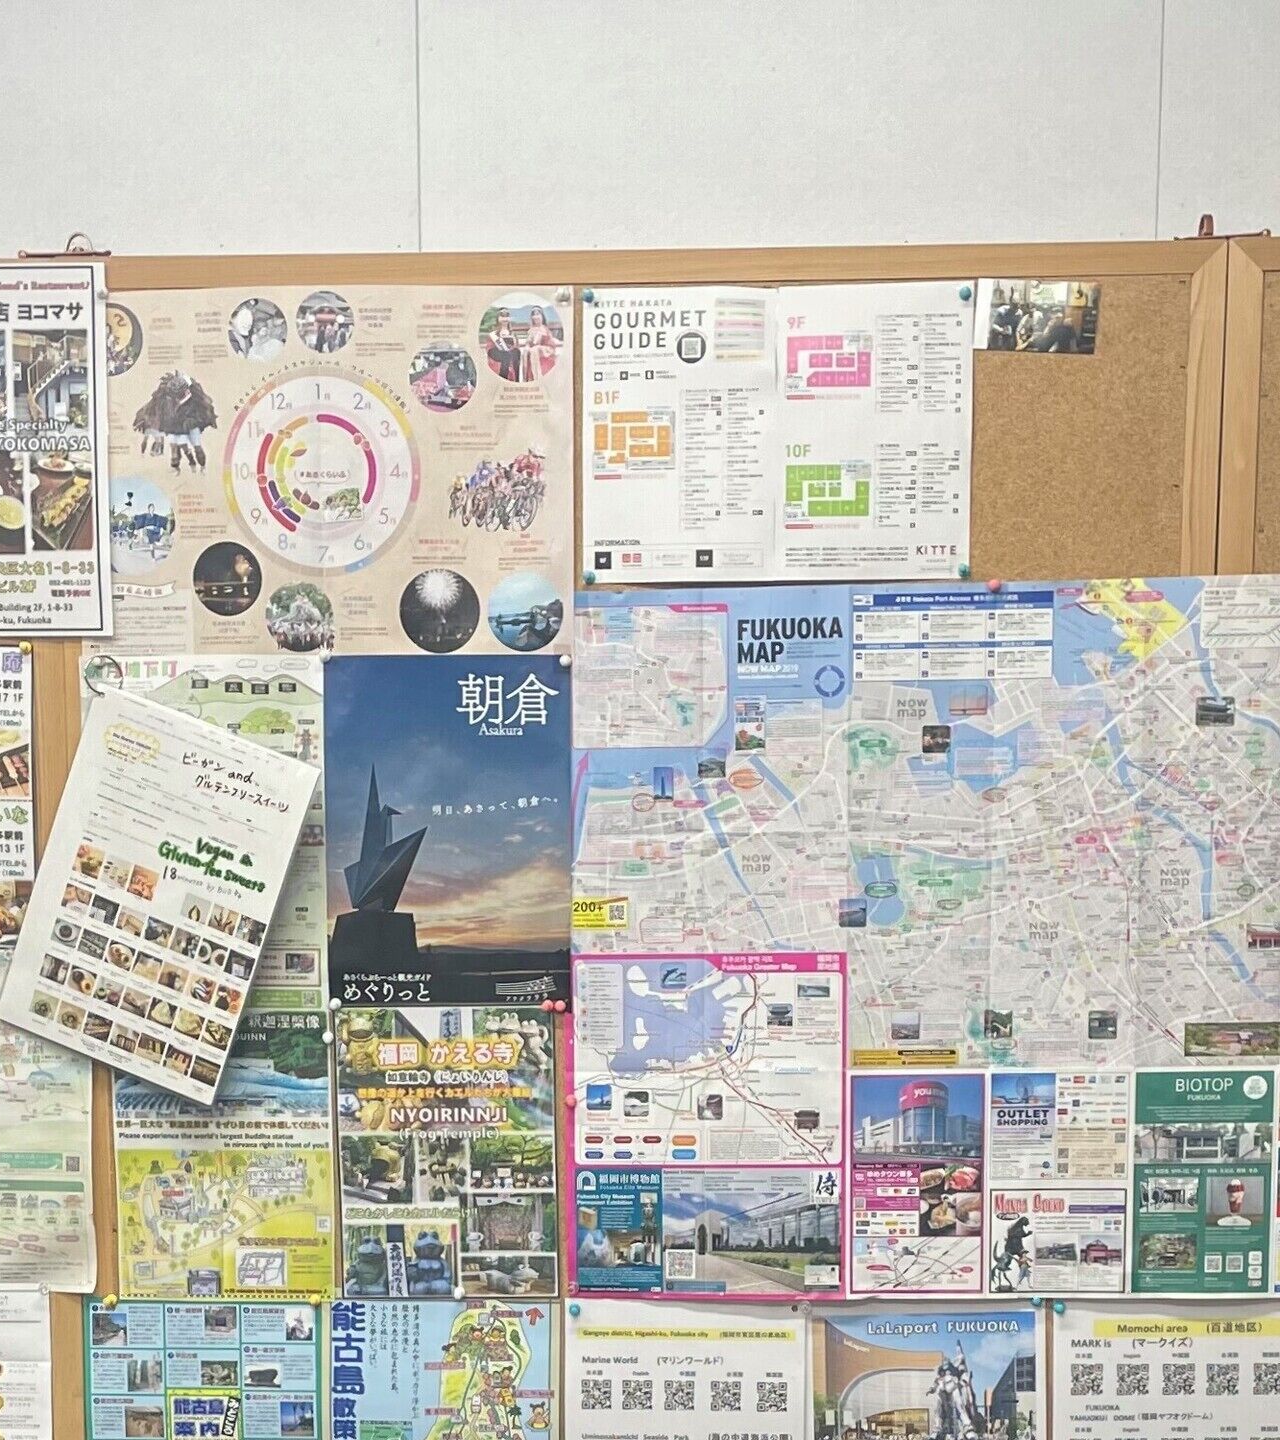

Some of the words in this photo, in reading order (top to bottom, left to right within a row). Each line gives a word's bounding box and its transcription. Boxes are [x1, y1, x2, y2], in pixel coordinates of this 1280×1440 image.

[594, 310, 707, 329] GOURMET
[787, 317, 806, 329] 9F
[594, 331, 667, 350] GUIDE
[594, 391, 620, 404] B1F
[9, 419, 68, 435] Specialty
[786, 444, 811, 457] 10F
[916, 545, 957, 556] KITTE
[737, 616, 842, 640] FUKUOKA
[737, 642, 785, 663] MAP
[13, 693, 23, 702] 1F
[456, 673, 560, 725] 朝倉
[897, 699, 927, 707] NOW
[897, 708, 926, 720] map
[478, 723, 523, 736] Asakura
[182, 752, 225, 772] ビーガン
[228, 771, 253, 784] and
[741, 854, 771, 862] NOW
[741, 863, 771, 873] map
[1160, 868, 1191, 877] NOW
[1160, 877, 1190, 888] map
[573, 901, 604, 914] 200+
[1029, 922, 1060, 930] NOW
[1029, 930, 1059, 941] map
[344, 982, 431, 1002] めぐりっと
[378, 1042, 419, 1066] 福岡
[431, 1042, 514, 1064] かえる寺
[1175, 1079, 1233, 1092] BIOTOP
[390, 1107, 507, 1123] NYOIRINNJI
[997, 1109, 1049, 1118] OUTLET
[599, 1174, 660, 1185] 福岡市博物館
[816, 1171, 838, 1197] 侍
[867, 1321, 938, 1337] LaLaport
[947, 1320, 1019, 1333] FUKUOKA
[1117, 1324, 1164, 1333] Momochi
[1166, 1325, 1188, 1333] area
[1206, 1322, 1263, 1334] (百道地区)
[582, 1356, 611, 1364] Marine
[613, 1356, 638, 1364] World
[657, 1356, 725, 1366] (マリンワールド)
[174, 1399, 225, 1415] 能古島
[174, 1421, 220, 1436] 案内
